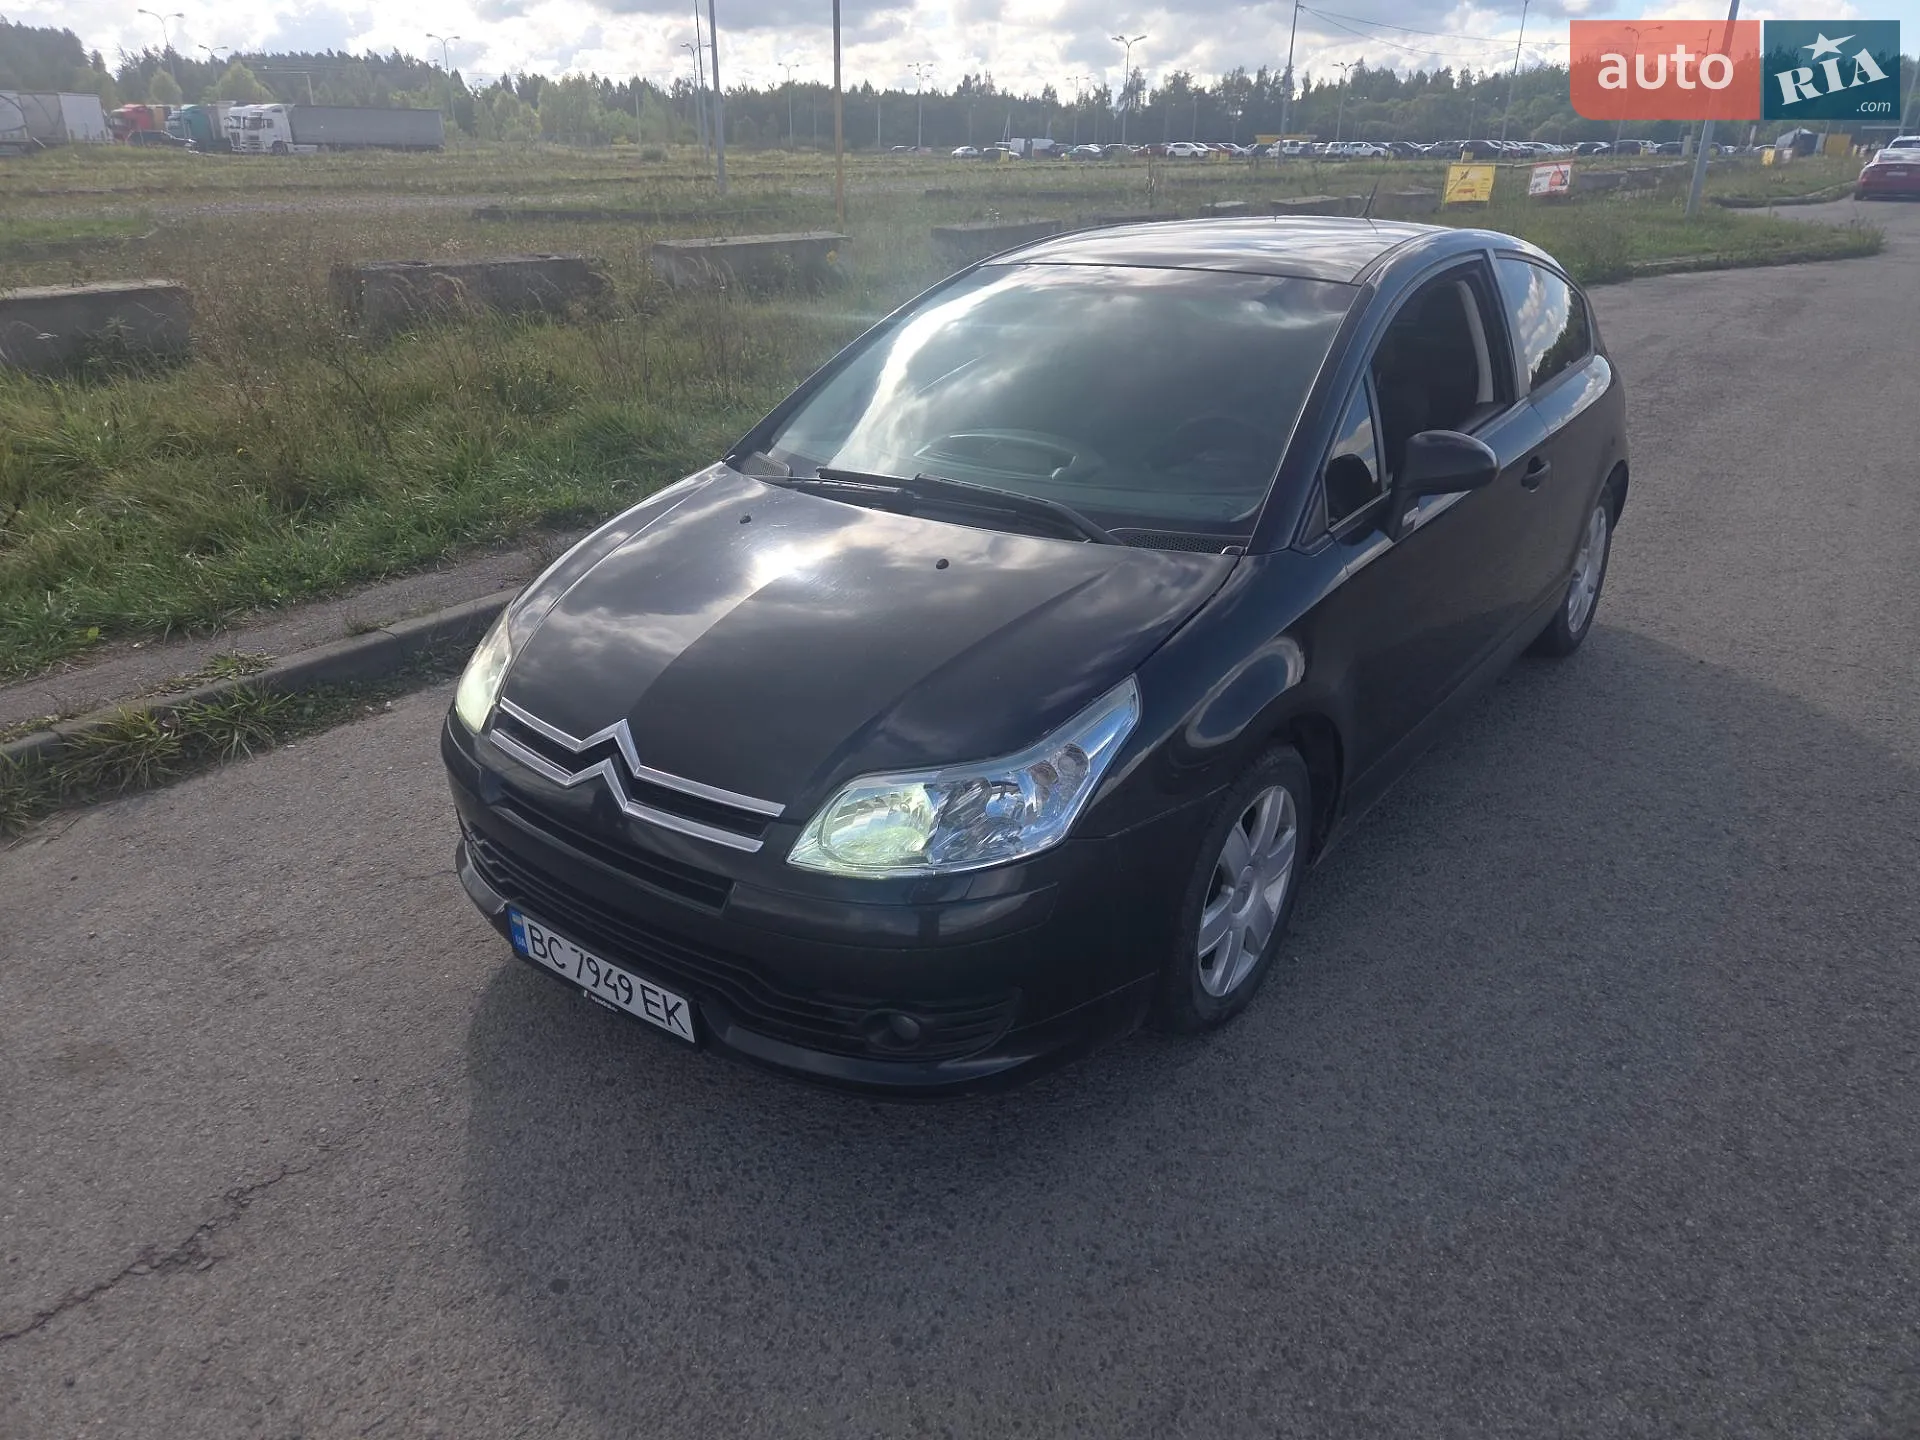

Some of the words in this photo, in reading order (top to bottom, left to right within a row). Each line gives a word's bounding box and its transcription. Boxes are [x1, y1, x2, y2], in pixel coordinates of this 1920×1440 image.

[529, 925, 565, 968] BC
[571, 948, 633, 1004] 7949
[641, 985, 688, 1034] EK
